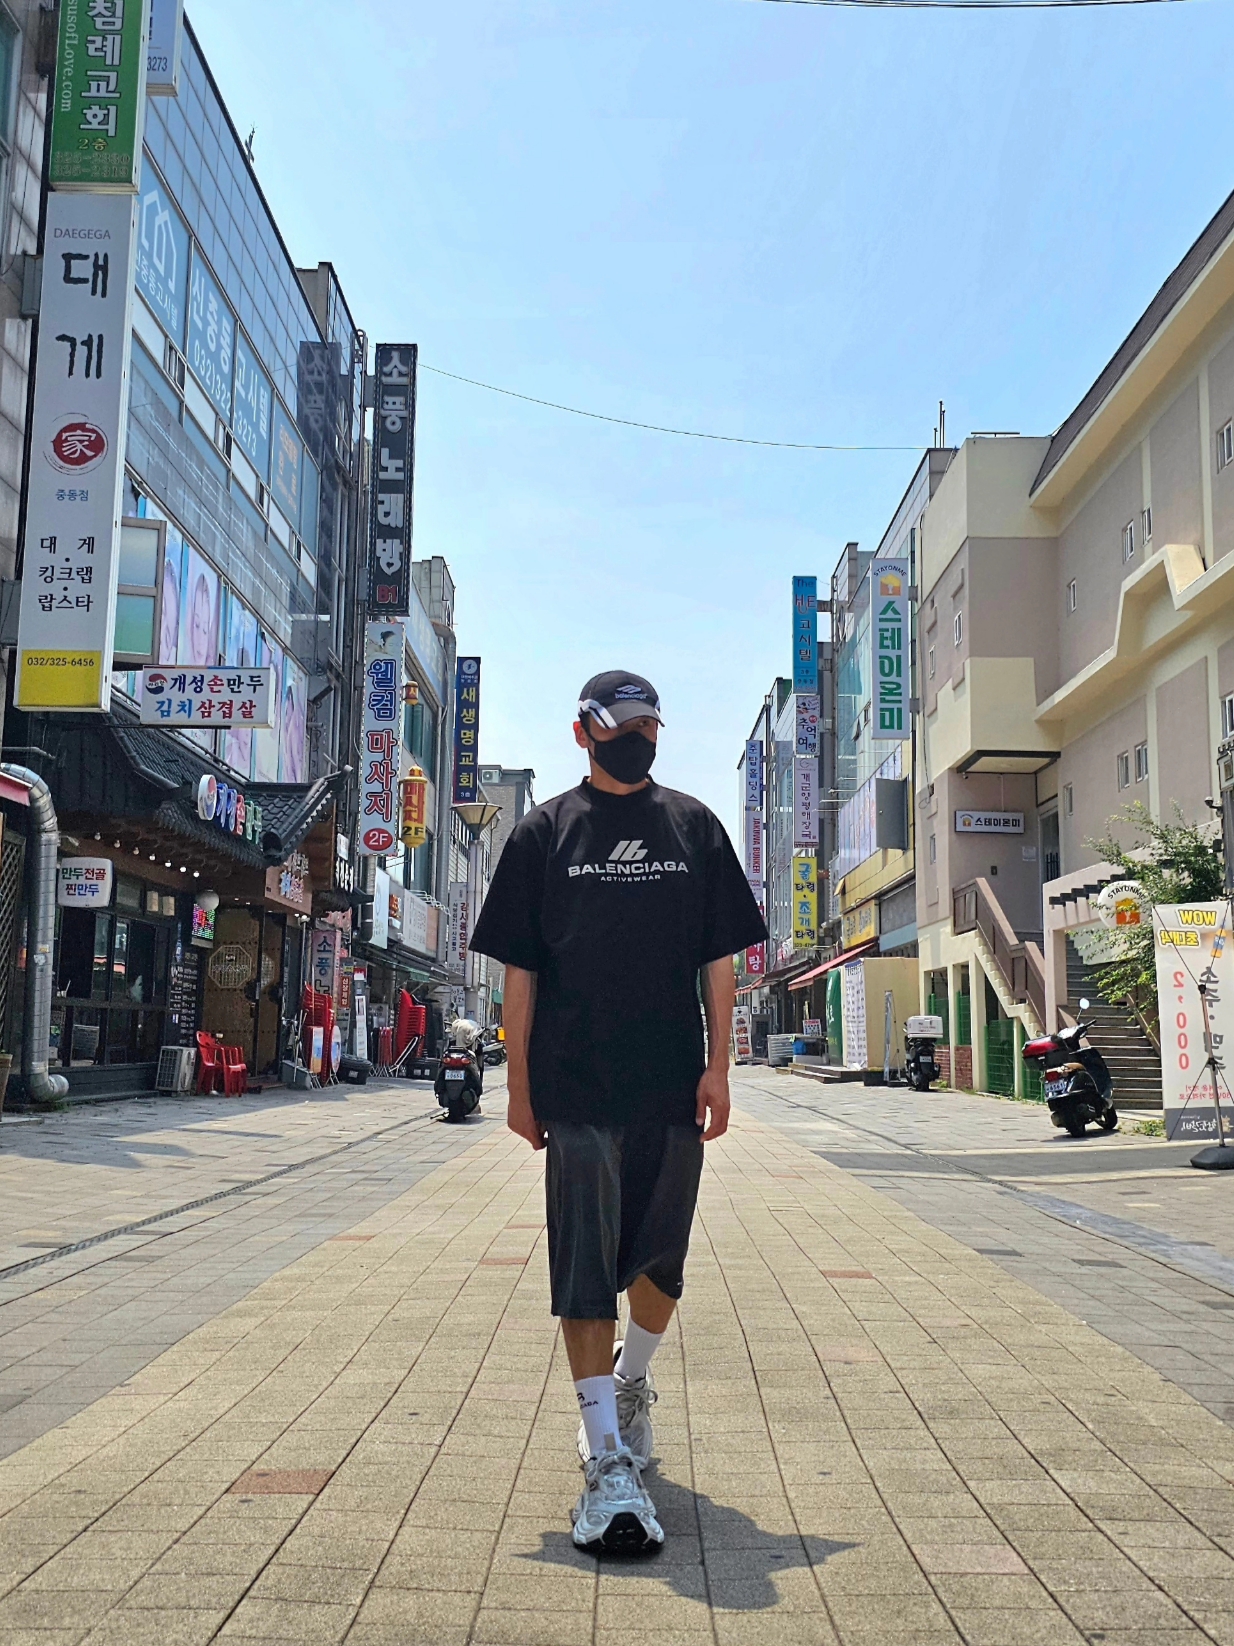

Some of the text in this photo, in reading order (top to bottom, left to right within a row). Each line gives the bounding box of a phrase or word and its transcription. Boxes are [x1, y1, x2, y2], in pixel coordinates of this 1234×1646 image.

[79, 0, 124, 138] 침례교회
[53, 228, 111, 240] DAEGEGA
[61, 430, 96, 458] 家
[55, 489, 89, 501] 중동점
[38, 565, 93, 584] 킹크랩
[873, 565, 907, 577] STAYONME
[37, 593, 94, 613] 랍스타
[27, 656, 95, 667] 032/325-6456
[878, 600, 903, 731] 스테이온미
[169, 673, 264, 694] 개성손만두
[154, 698, 257, 720] 김치삼겹살
[365, 658, 398, 822] 웰컴 마사지
[458, 686, 476, 789] 새생명교회
[402, 825, 424, 836] 2F
[975, 817, 1020, 828] 스테이온미
[369, 831, 389, 845] 2F
[61, 866, 107, 881] 만두전골
[568, 861, 689, 878] BALENCIAGA
[600, 874, 661, 882] ACTIVEWEAR
[65, 883, 100, 897] 찐만두
